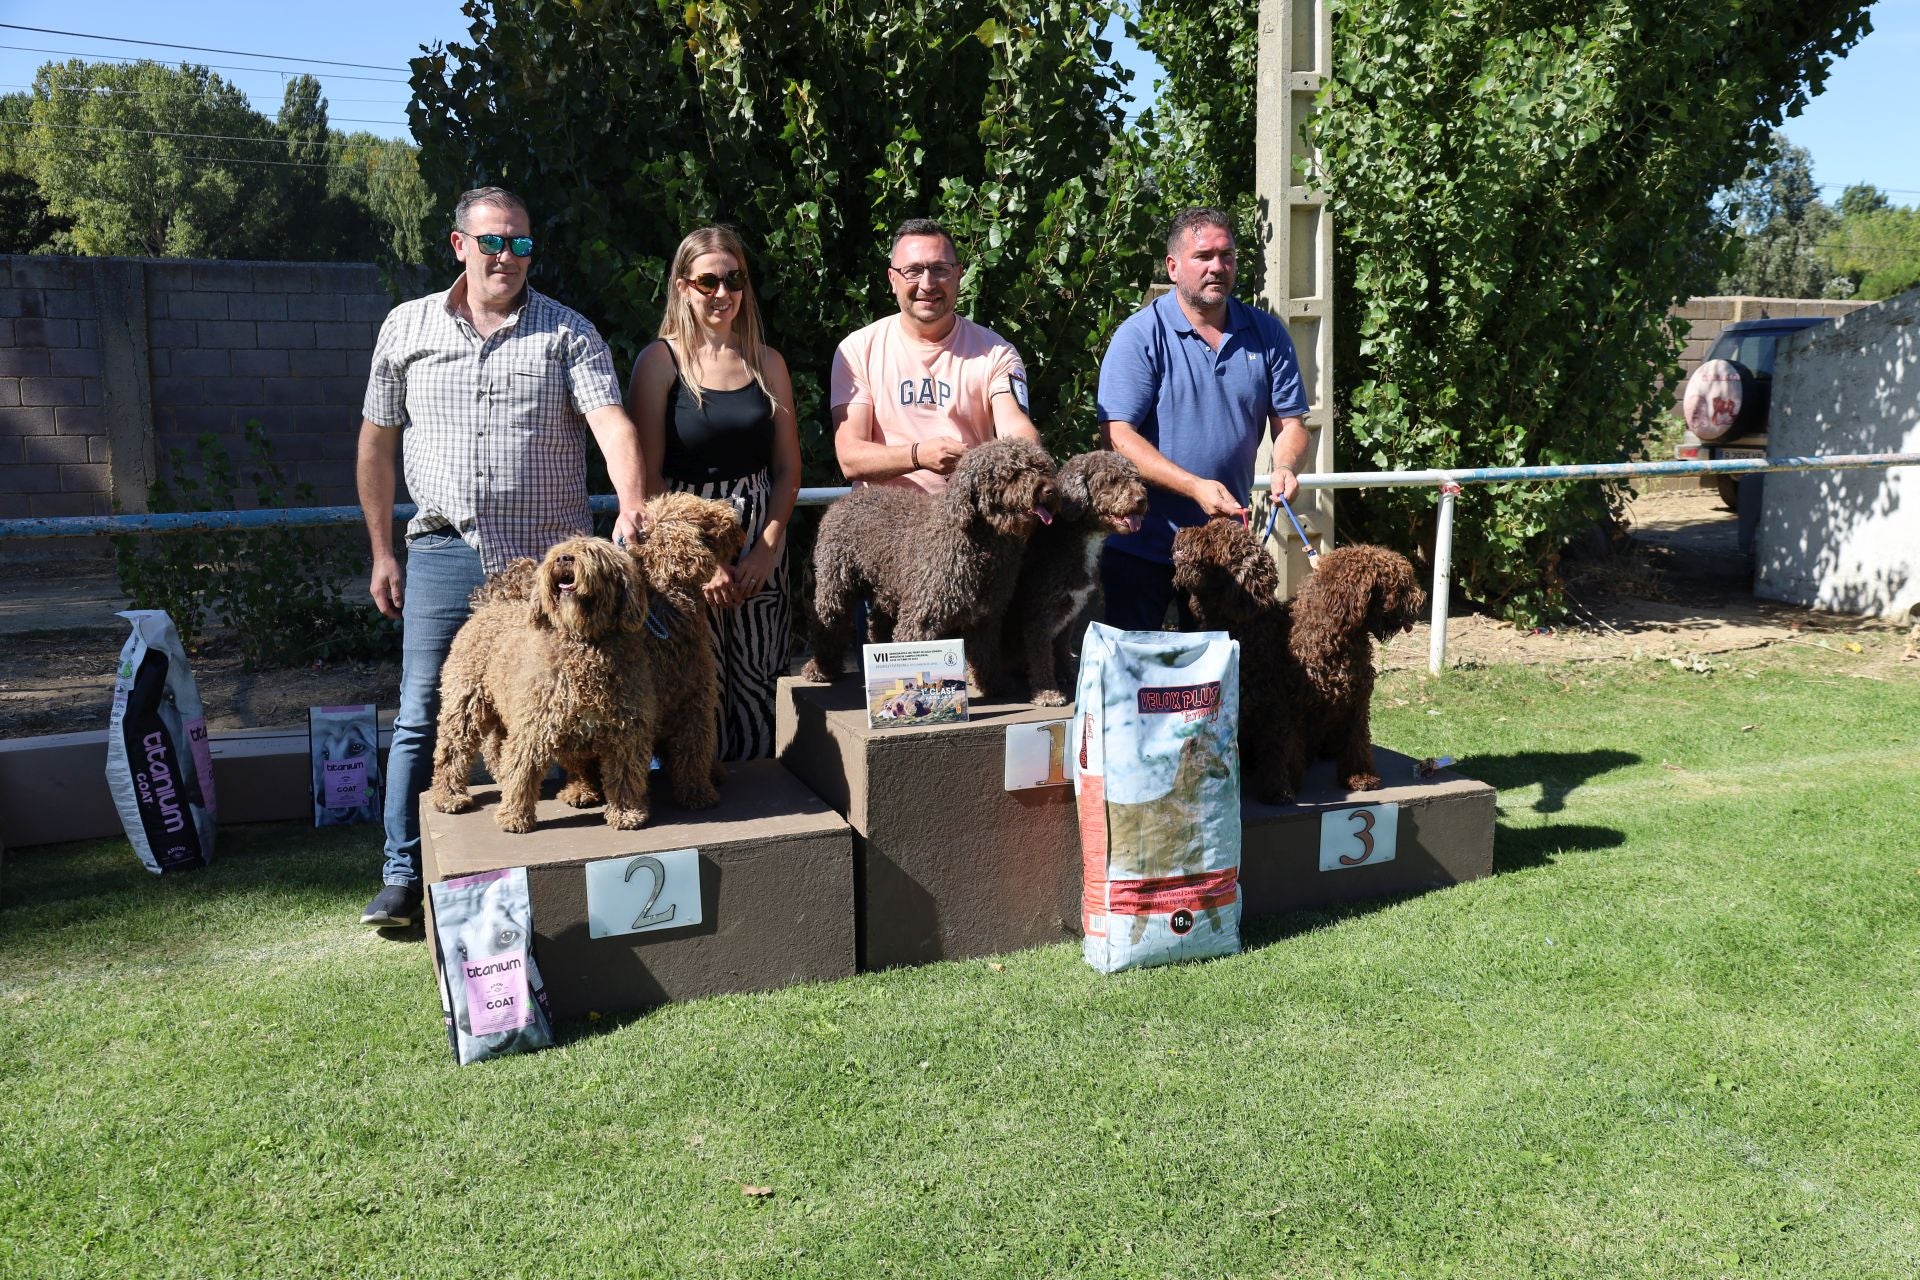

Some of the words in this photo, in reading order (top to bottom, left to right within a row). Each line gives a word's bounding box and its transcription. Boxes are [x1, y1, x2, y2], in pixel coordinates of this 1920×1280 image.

[900, 378, 951, 407] GAP
[873, 652, 889, 663] VII
[929, 686, 956, 696] CLASE
[1140, 691, 1181, 710] VELOX
[1181, 685, 1220, 709] PLUS
[1035, 721, 1074, 786] 1
[326, 761, 364, 771] titanium
[136, 772, 154, 804] COAT
[143, 730, 184, 833] titanium
[336, 785, 357, 793] COAT
[1339, 809, 1376, 866] 3
[624, 855, 677, 930] 2
[1174, 916, 1184, 927] 18
[466, 958, 522, 978] titanium
[486, 996, 515, 1010] COAT
